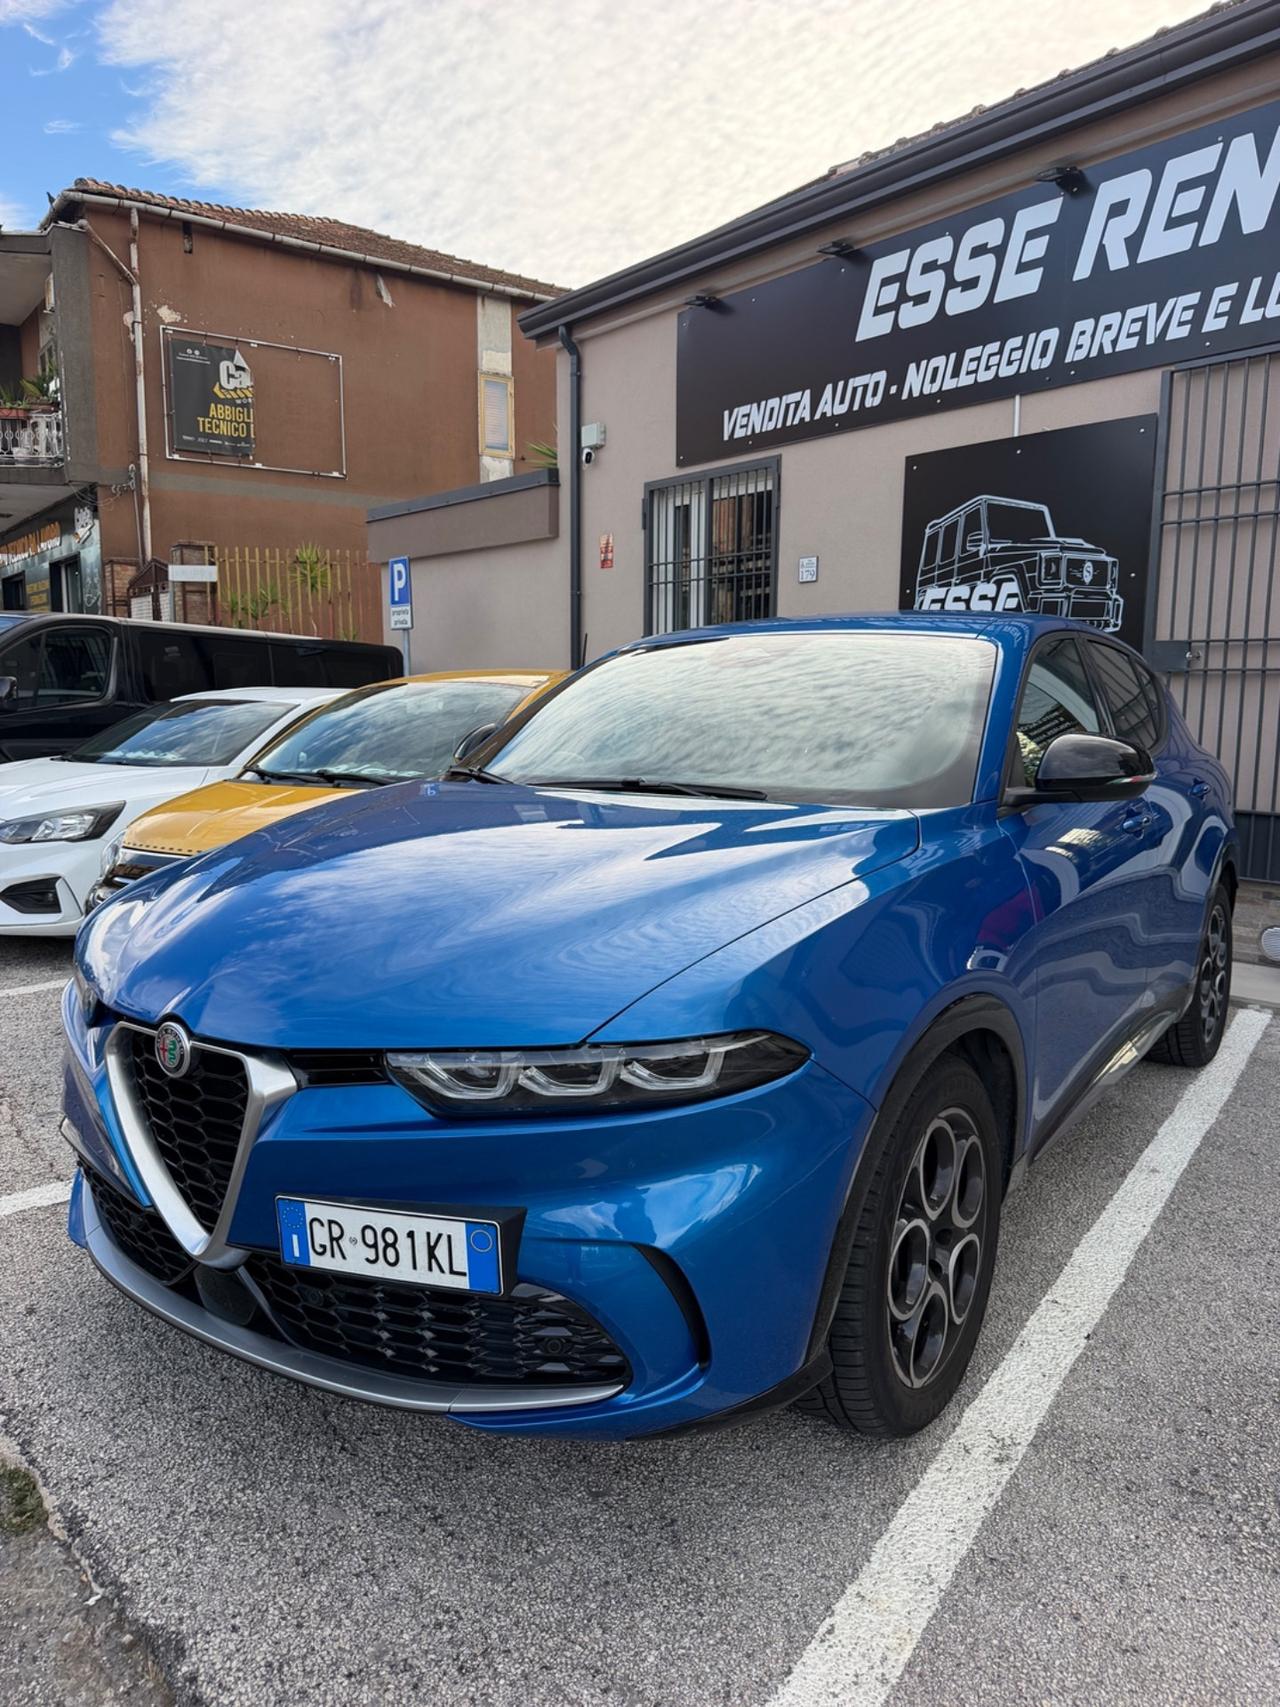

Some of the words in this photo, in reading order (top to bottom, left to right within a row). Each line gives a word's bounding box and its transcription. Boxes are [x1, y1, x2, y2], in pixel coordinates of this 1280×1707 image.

[855, 196, 1064, 342] ESSE
[1072, 125, 1280, 281] REN
[723, 389, 811, 441] VENDITA
[814, 370, 887, 420] AUTO
[901, 327, 1060, 400] NOLEGGIO
[1064, 291, 1201, 363] BREVE
[1201, 282, 1239, 333] E
[197, 416, 247, 437] TECNICO
[393, 563, 407, 601] P
[309, 1217, 347, 1260] GR
[360, 1224, 468, 1277] 981KL
